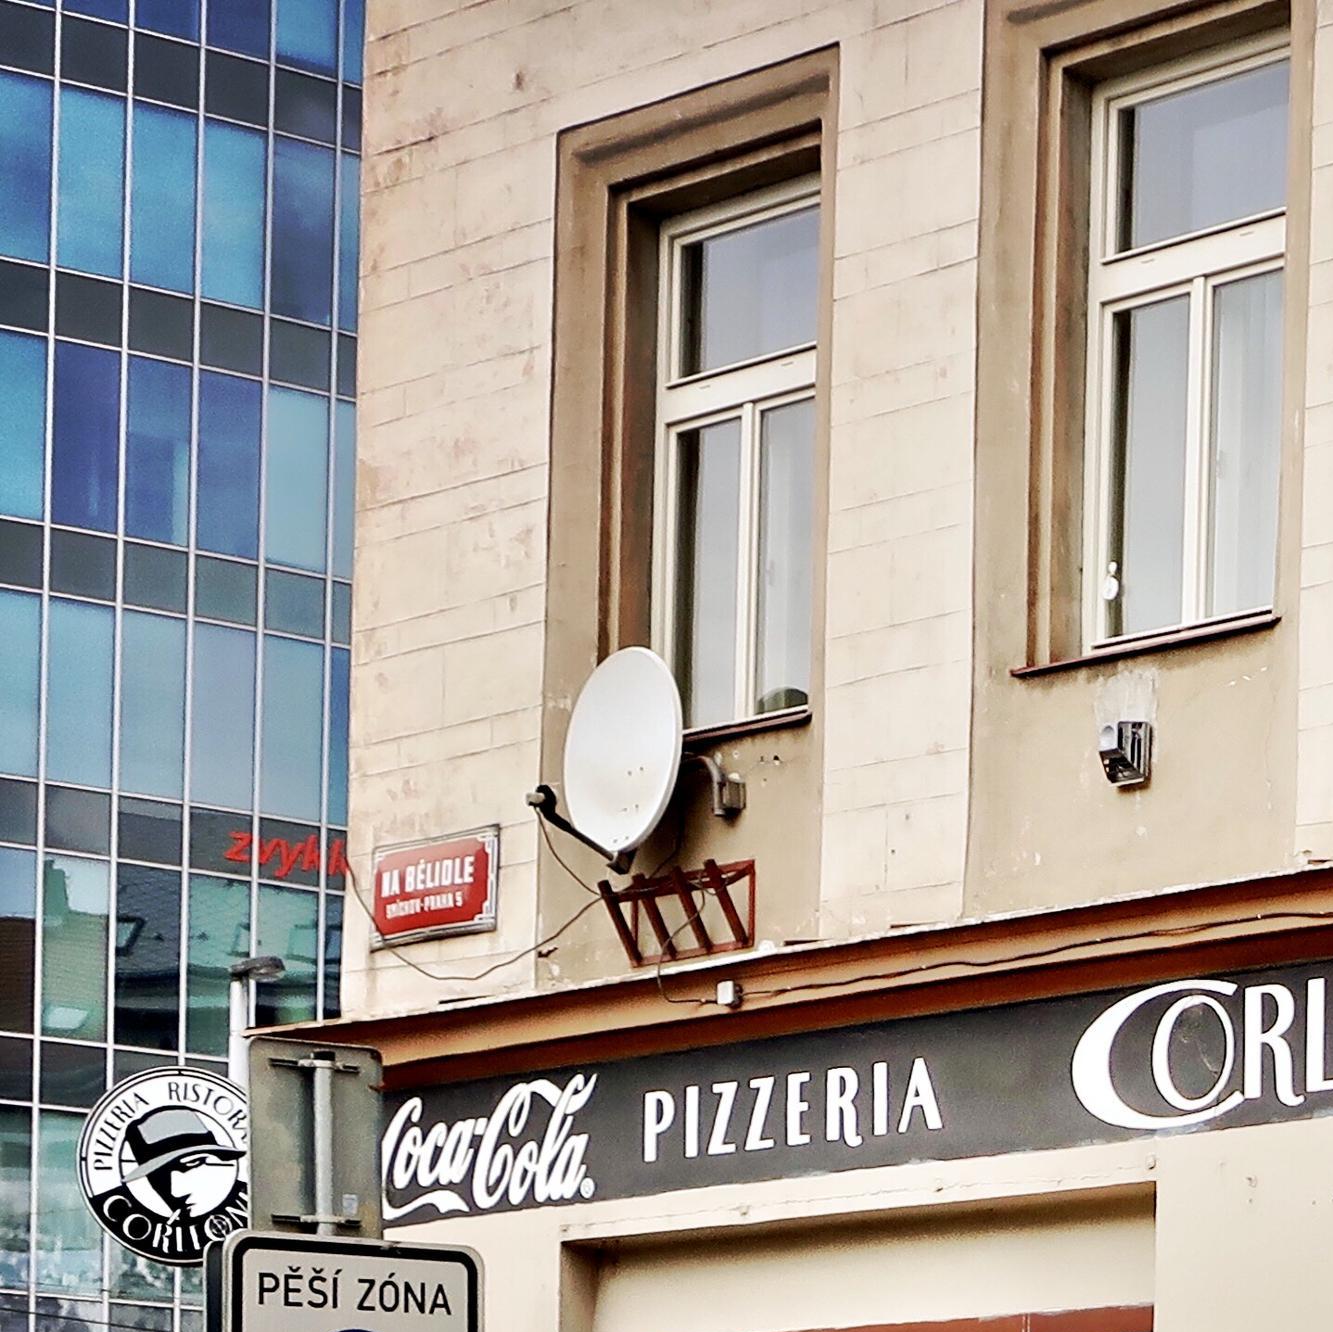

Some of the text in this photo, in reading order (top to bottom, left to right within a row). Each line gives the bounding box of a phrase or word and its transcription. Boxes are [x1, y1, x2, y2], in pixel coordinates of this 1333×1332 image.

[381, 868, 401, 898] NA
[455, 890, 464, 907] 5
[93, 1092, 150, 1171] PIZZERIA
[642, 1056, 944, 1163] PIZZERIA
[381, 1072, 598, 1221] Coca-Cola
[258, 1265, 452, 1316] PĚŠÍ ZÓNA
